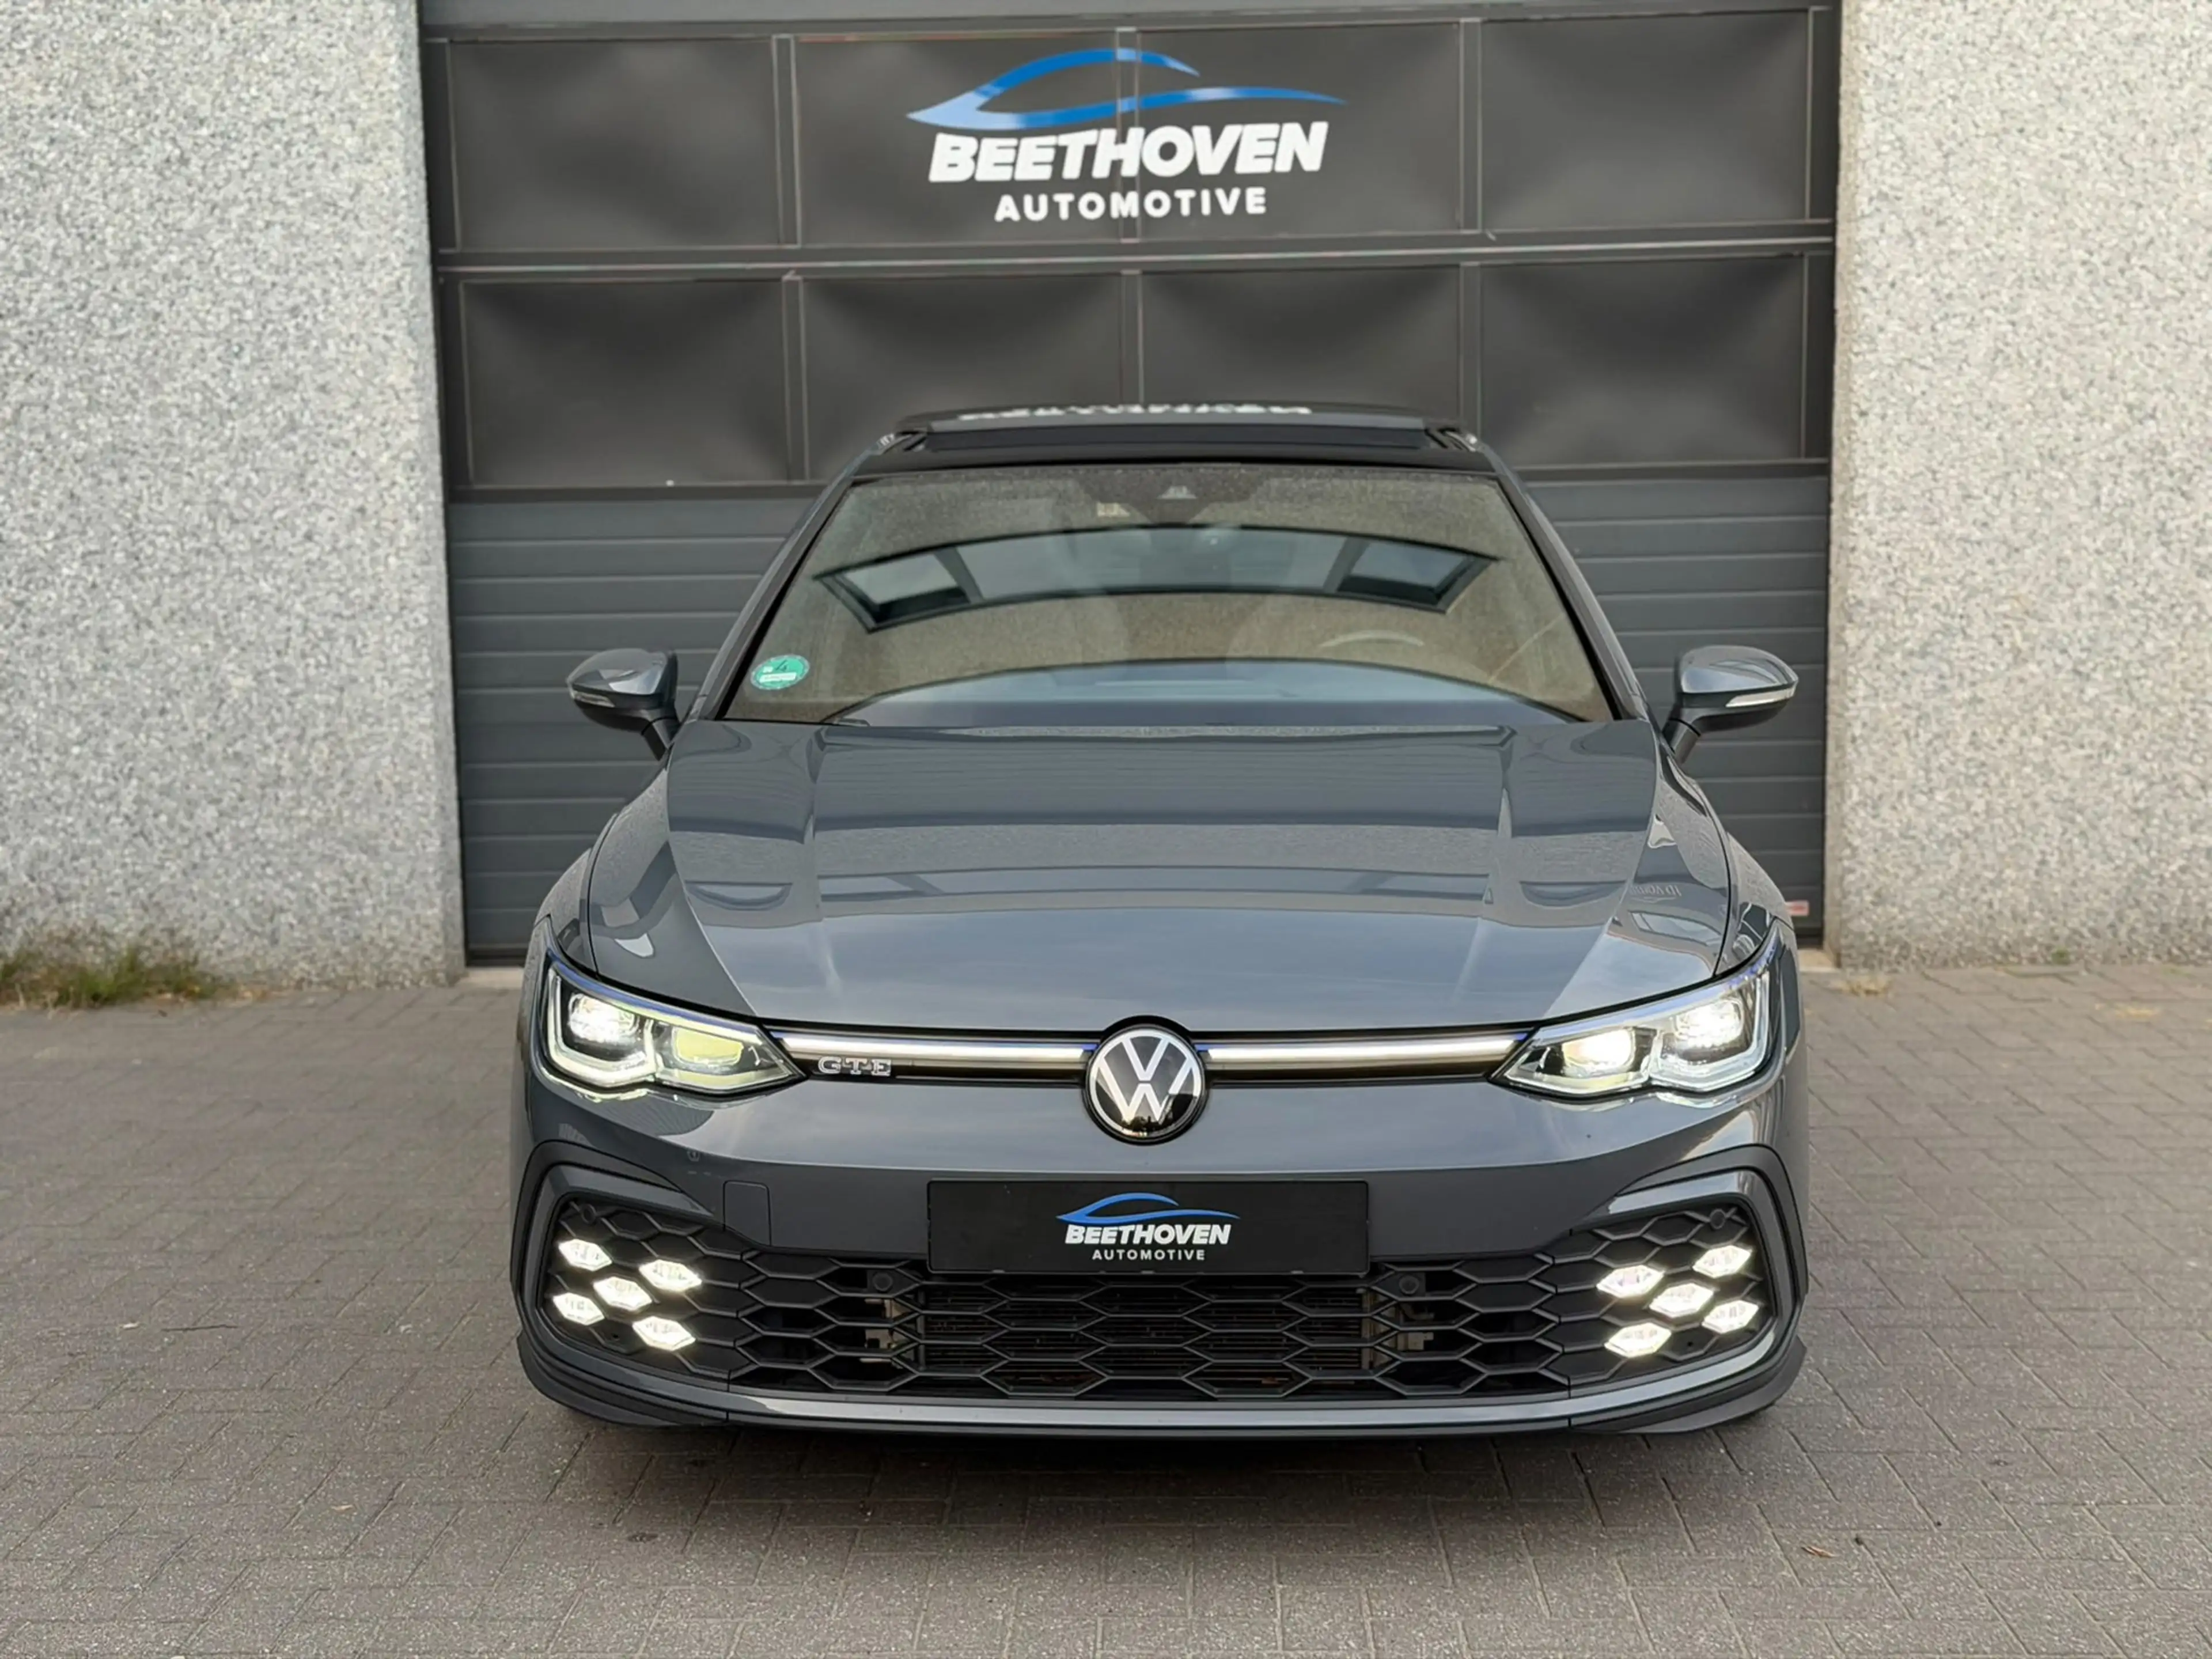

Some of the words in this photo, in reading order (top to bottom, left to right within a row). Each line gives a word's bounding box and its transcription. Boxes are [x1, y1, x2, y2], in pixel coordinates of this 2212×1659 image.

[929, 122, 1328, 182] BEETHOVEN
[994, 187, 1266, 222] AUTOMOTIVE
[817, 1056, 892, 1077] GTE
[1065, 1224, 1232, 1244] BEETHOVEN
[1092, 1249, 1206, 1261] AUTOMOTIVE
